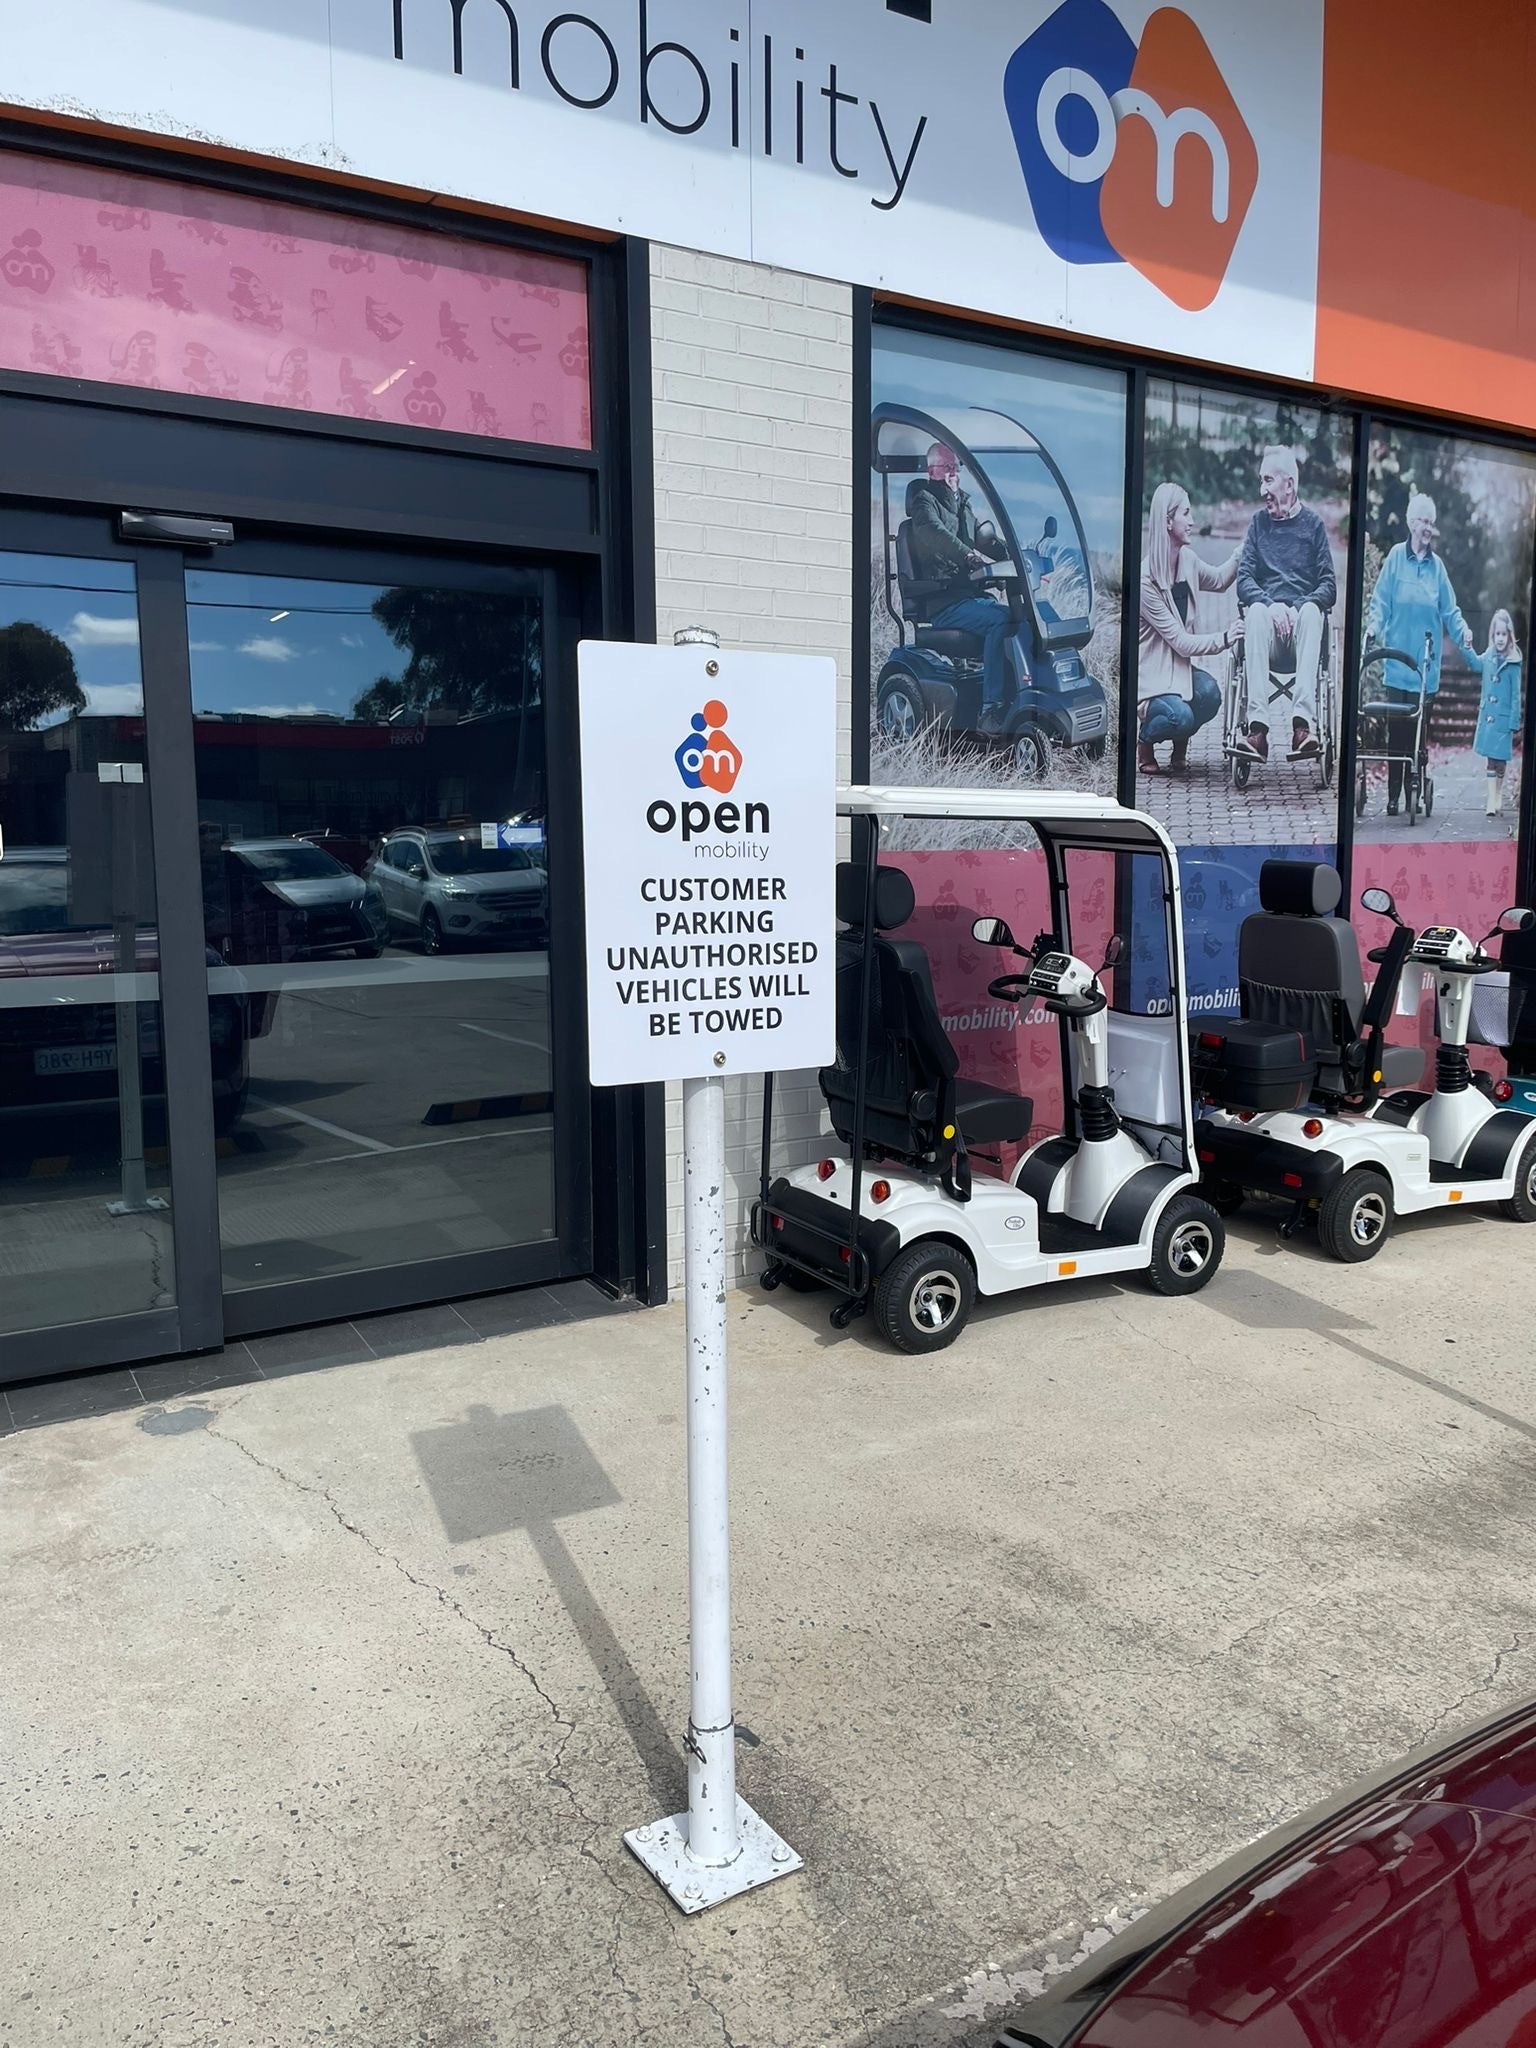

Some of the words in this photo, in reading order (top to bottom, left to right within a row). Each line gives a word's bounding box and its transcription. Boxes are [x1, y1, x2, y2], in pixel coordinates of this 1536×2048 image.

[393, 0, 928, 210] mobility
[1036, 66, 1230, 224] om
[682, 748, 735, 774] om
[646, 799, 770, 842] open
[694, 841, 770, 862] mobility
[640, 877, 787, 902] CUSTOMER
[656, 910, 774, 935] PARKING
[607, 942, 818, 971] UNAUTHORISED
[616, 976, 742, 1004] VEHICLES
[749, 973, 810, 998] WILL
[650, 1012, 681, 1037] BE
[689, 1007, 783, 1034] TOWED
